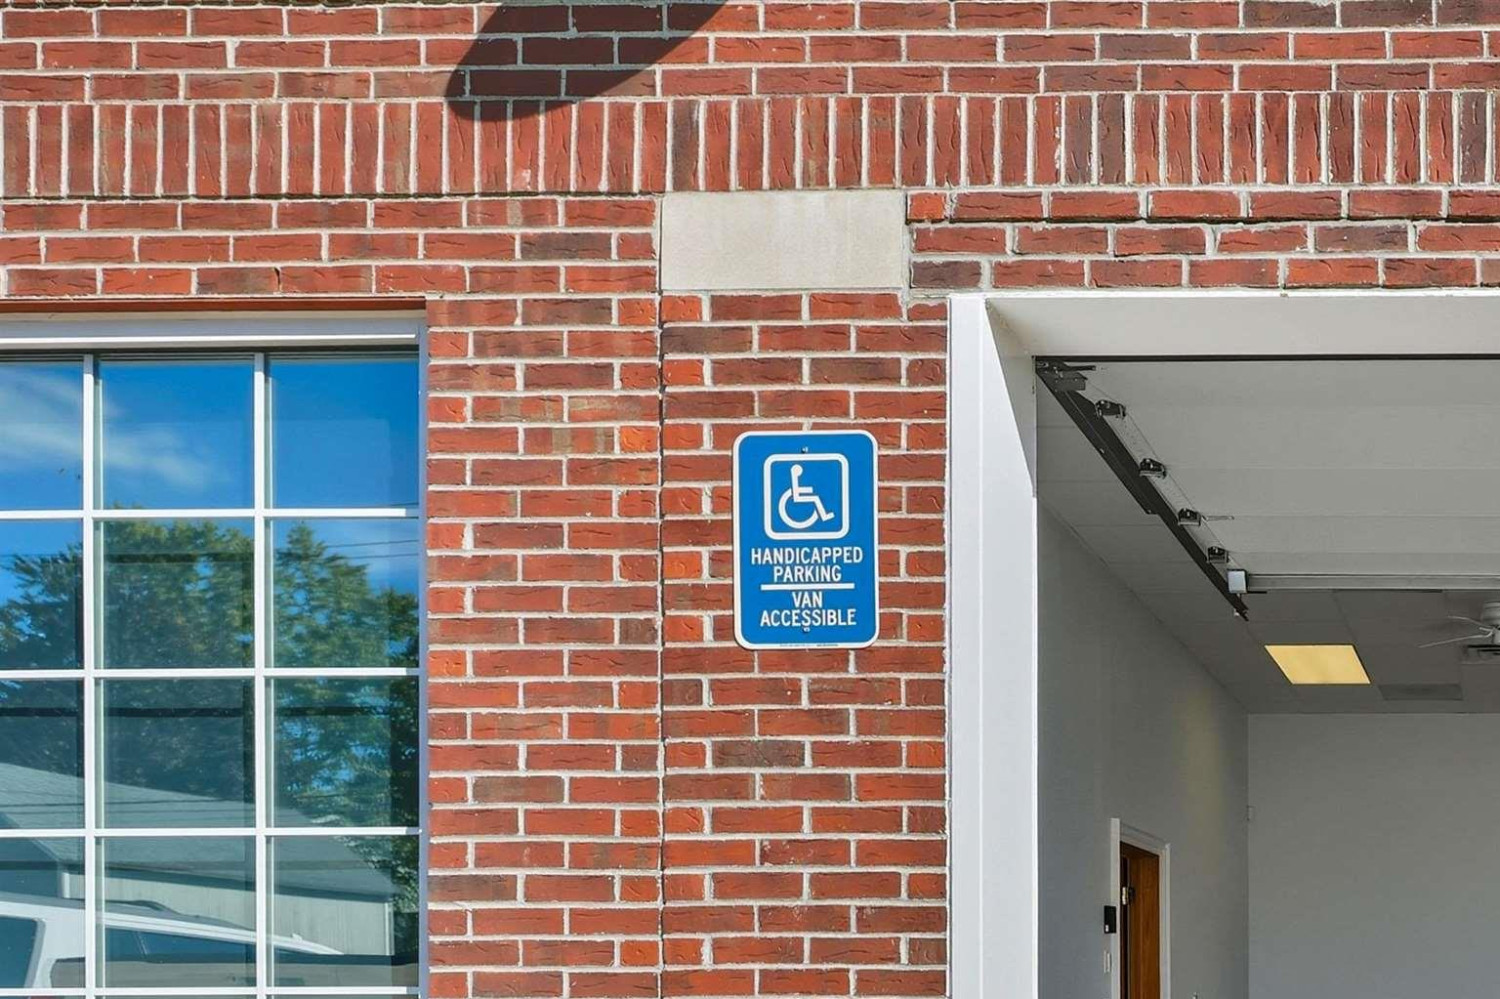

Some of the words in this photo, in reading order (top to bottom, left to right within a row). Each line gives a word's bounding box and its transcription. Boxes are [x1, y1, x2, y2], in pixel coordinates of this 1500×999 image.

[751, 547, 863, 565] HANDICAPPED
[773, 565, 842, 582] PARKING
[792, 591, 822, 608] VAN
[760, 608, 857, 627] ACCESSIBLE
